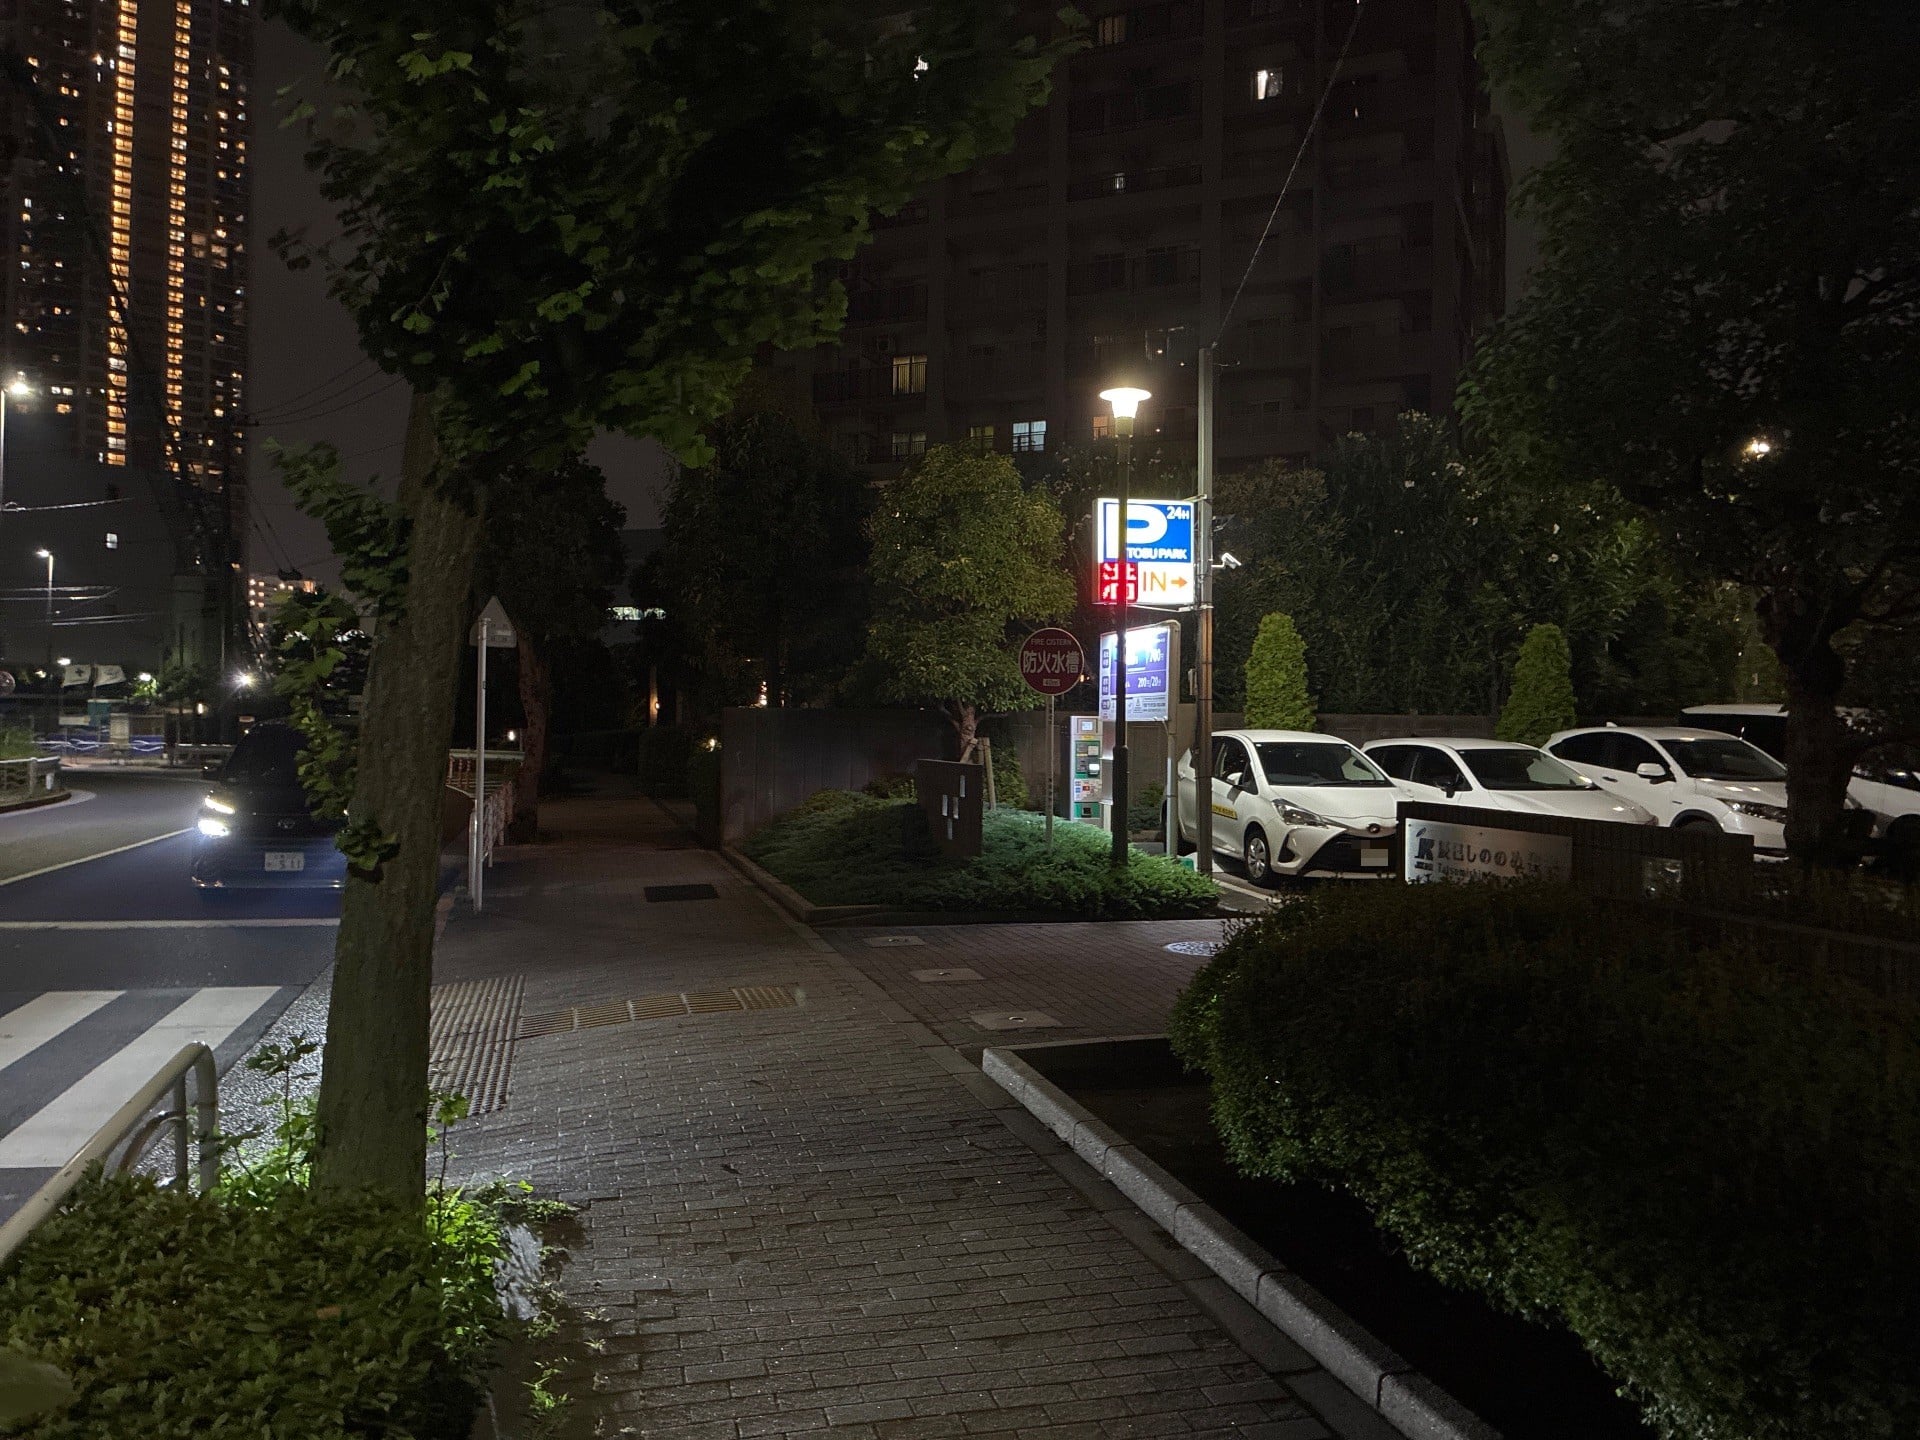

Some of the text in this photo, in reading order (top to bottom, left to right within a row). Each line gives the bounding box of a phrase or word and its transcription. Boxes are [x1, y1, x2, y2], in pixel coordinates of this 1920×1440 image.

[1166, 506, 1190, 520] 24H
[1105, 503, 1168, 559] P
[1126, 547, 1188, 560] TOBU PARK
[1143, 571, 1166, 592] IN
[1031, 638, 1072, 646] FIRE CISTERN
[1023, 650, 1080, 674] 防火水槽
